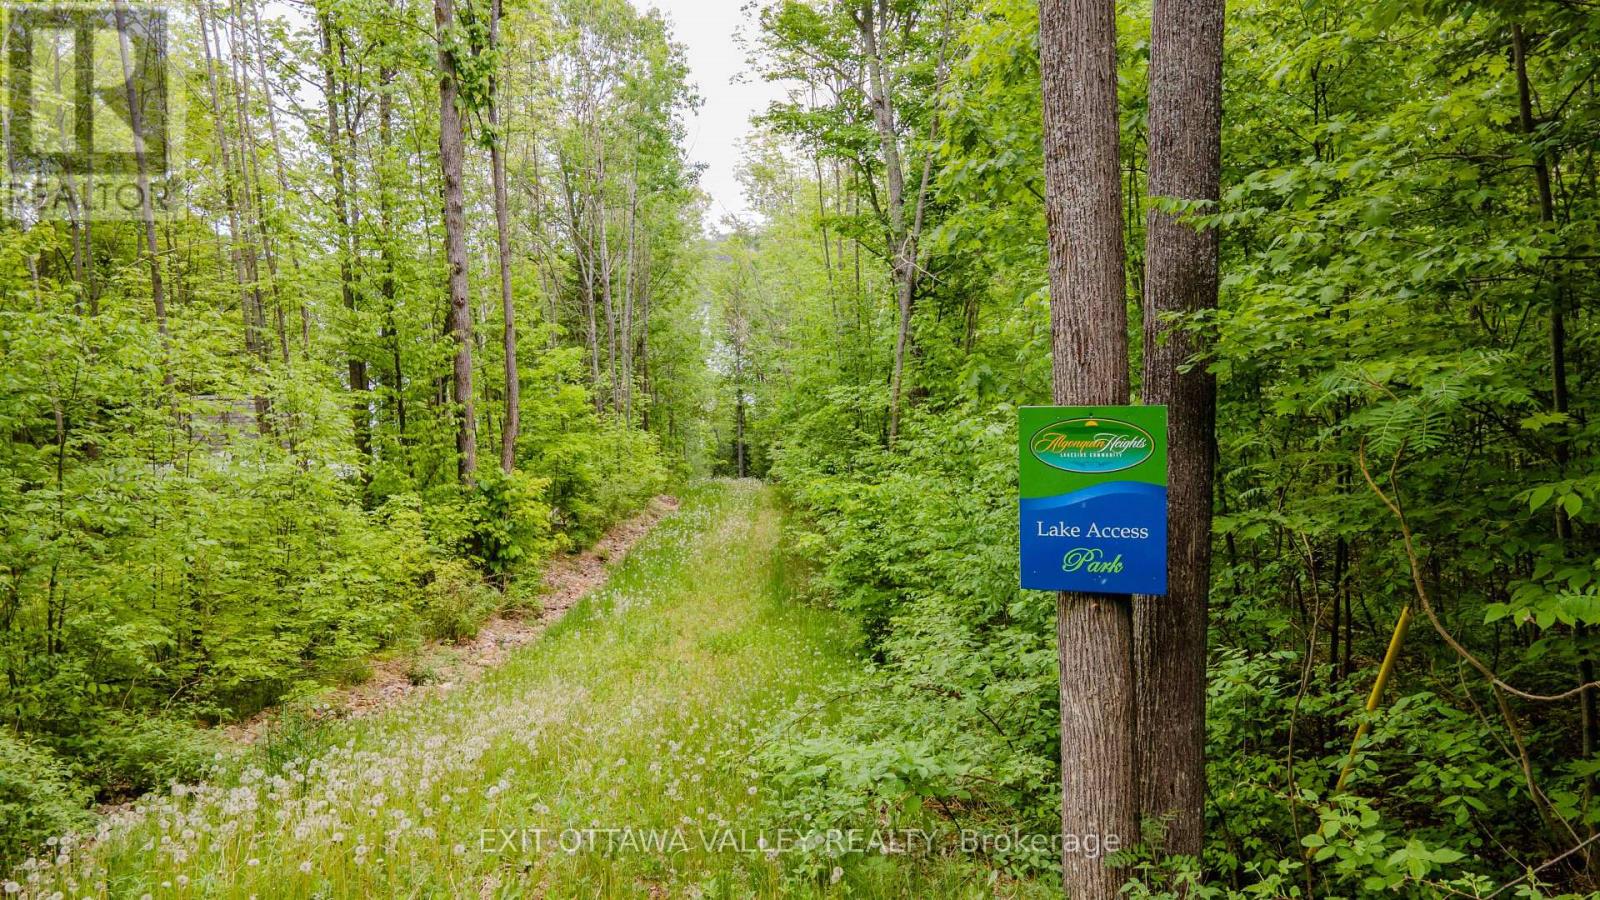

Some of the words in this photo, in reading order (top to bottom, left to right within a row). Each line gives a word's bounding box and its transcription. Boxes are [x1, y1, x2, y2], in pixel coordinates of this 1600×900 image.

[1035, 432, 1105, 454] Algonquin
[1094, 432, 1147, 454] Heights
[1036, 521, 1081, 537] Lake
[1086, 522, 1149, 539] Access
[1062, 547, 1124, 574] Park
